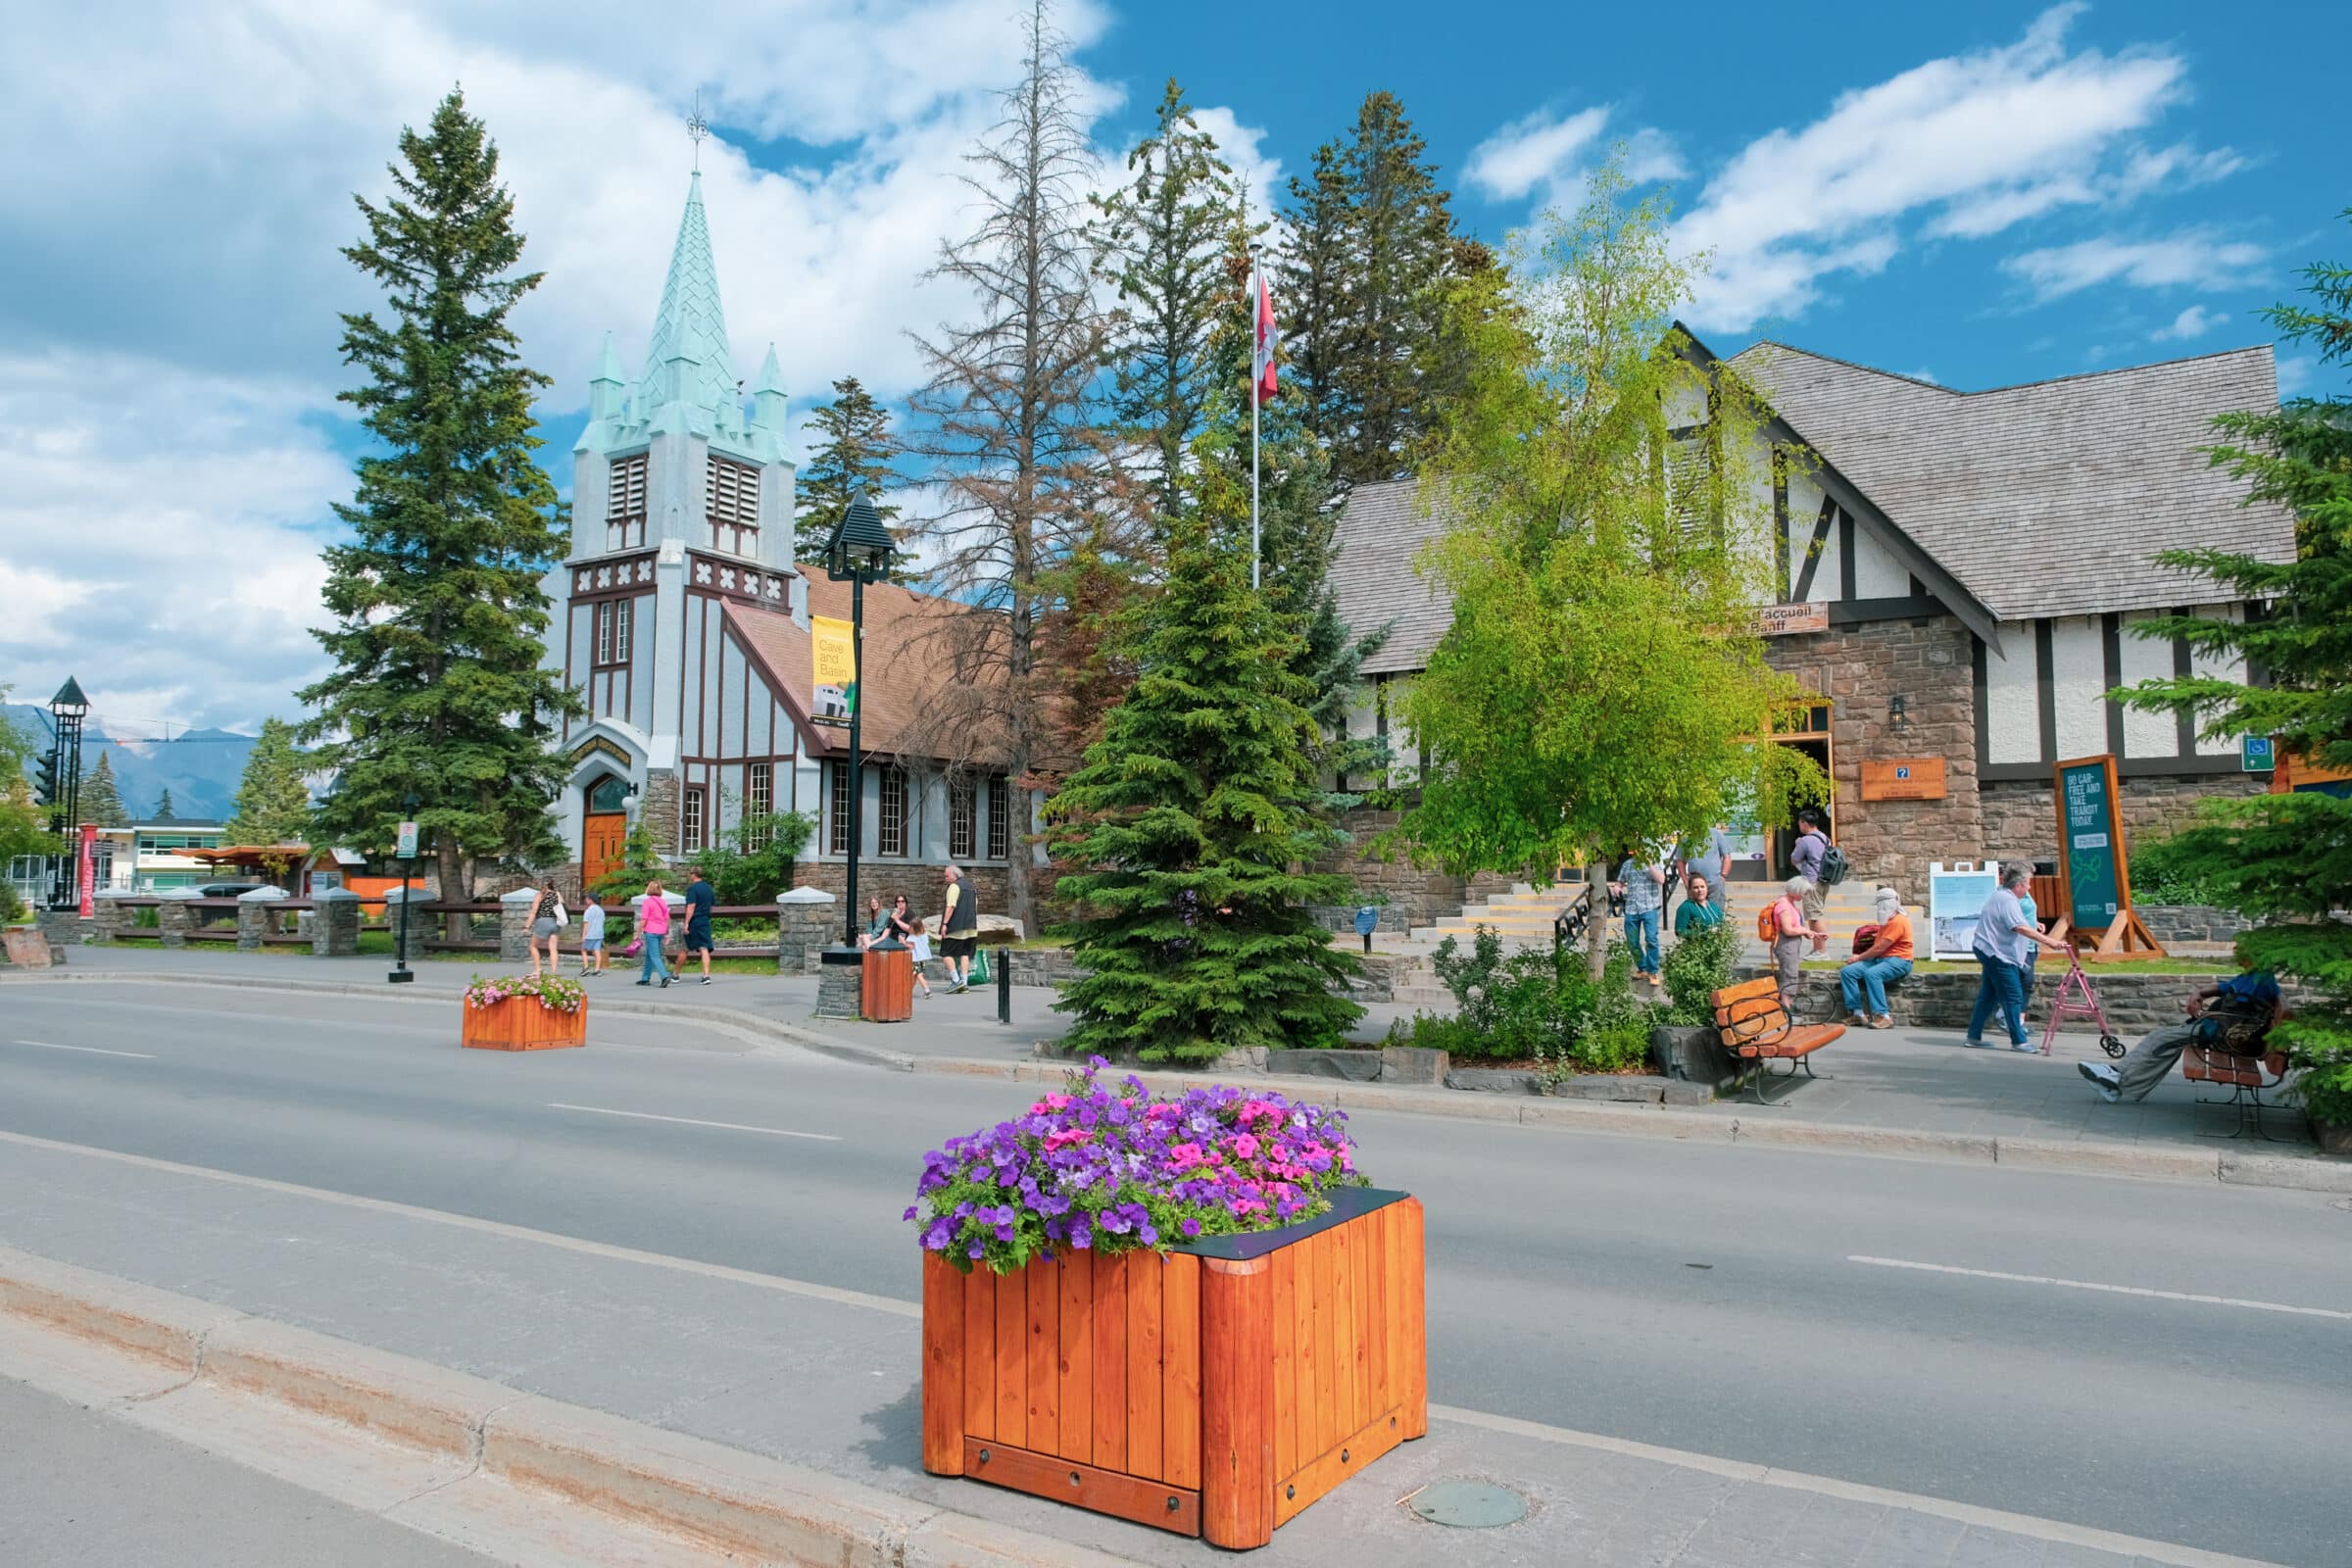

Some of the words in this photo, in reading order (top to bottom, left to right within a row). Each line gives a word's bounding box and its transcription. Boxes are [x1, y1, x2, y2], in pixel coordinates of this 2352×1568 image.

[1750, 619, 1787, 633] Banff
[819, 640, 844, 655] Cave
[819, 654, 839, 664] and
[820, 663, 847, 678] Basin
[2078, 773, 2094, 784] CAR-
[2069, 784, 2085, 796] FREE
[2086, 783, 2101, 794] AND
[2070, 795, 2086, 805] TAKE
[2070, 804, 2098, 816] TRANSIT
